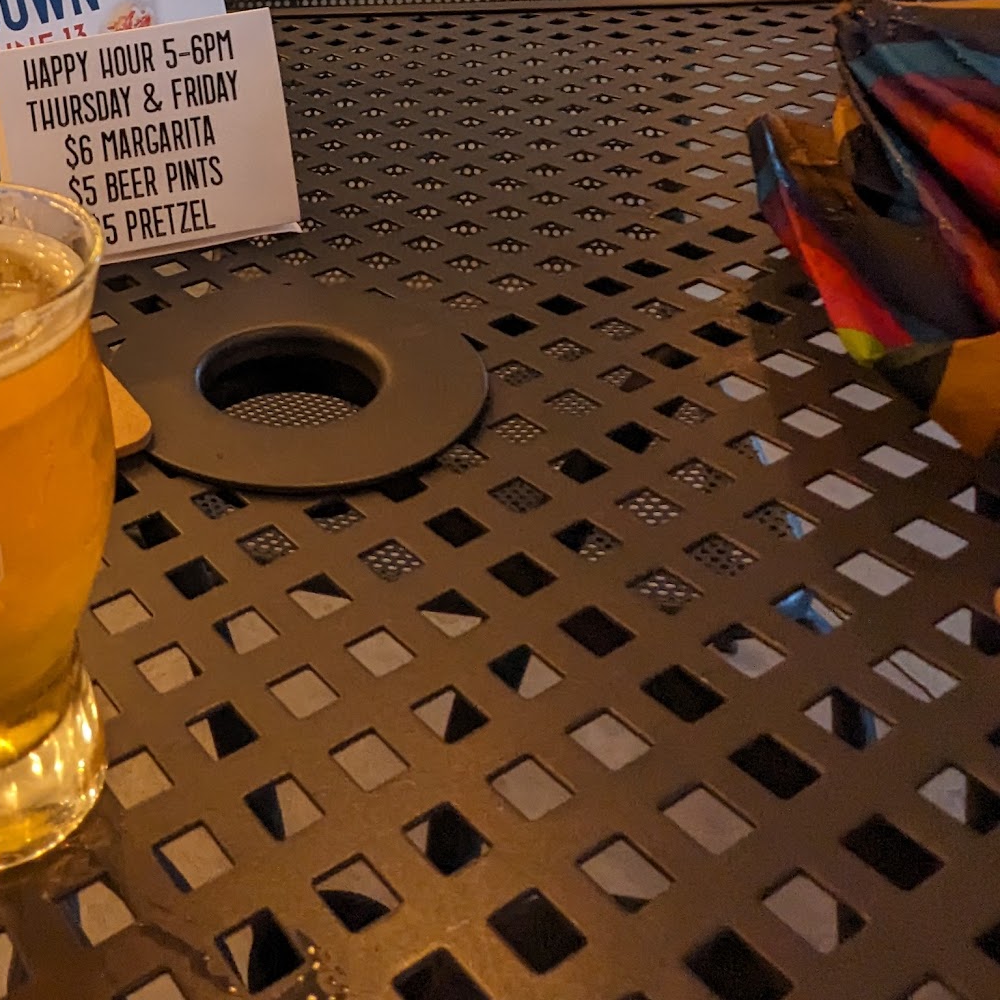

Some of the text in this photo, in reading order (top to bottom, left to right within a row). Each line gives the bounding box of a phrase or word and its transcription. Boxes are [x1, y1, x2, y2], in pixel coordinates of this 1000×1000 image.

[23, 50, 88, 91] HAPPY
[99, 42, 156, 79] HOUR
[162, 29, 234, 69] 5-6PM
[26, 70, 238, 132] THURSDAY & FRIDAY
[64, 114, 216, 170] $6 MARGARITA
[69, 156, 223, 206] $5 BEER PINTS
[93, 198, 216, 244] 5 PRETZEL
